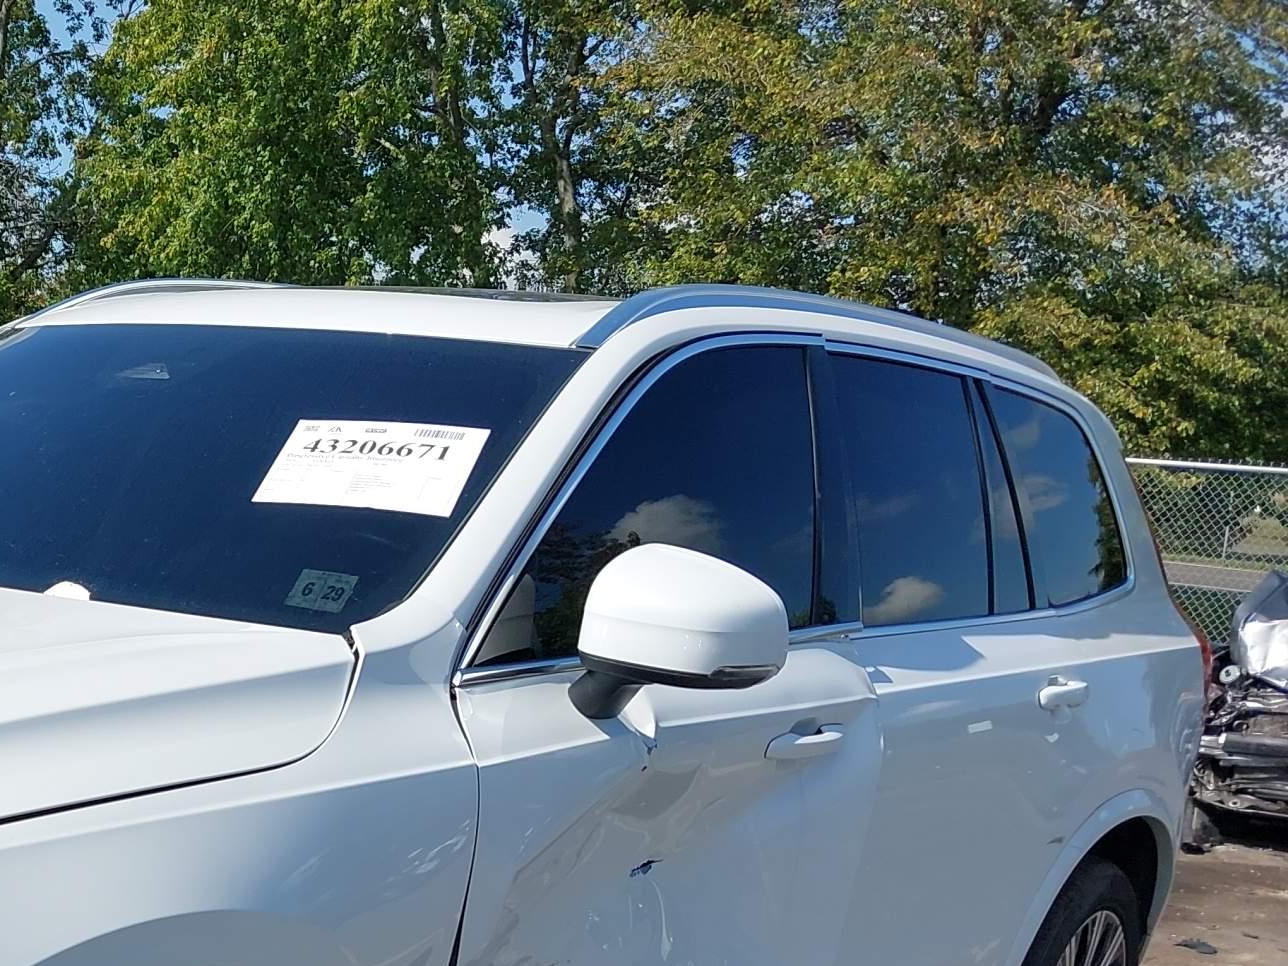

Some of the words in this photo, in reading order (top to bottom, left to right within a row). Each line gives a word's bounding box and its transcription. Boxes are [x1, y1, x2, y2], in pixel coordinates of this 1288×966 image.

[302, 438, 452, 461] 43206671
[302, 582, 316, 597] 6
[320, 585, 345, 601] 29
